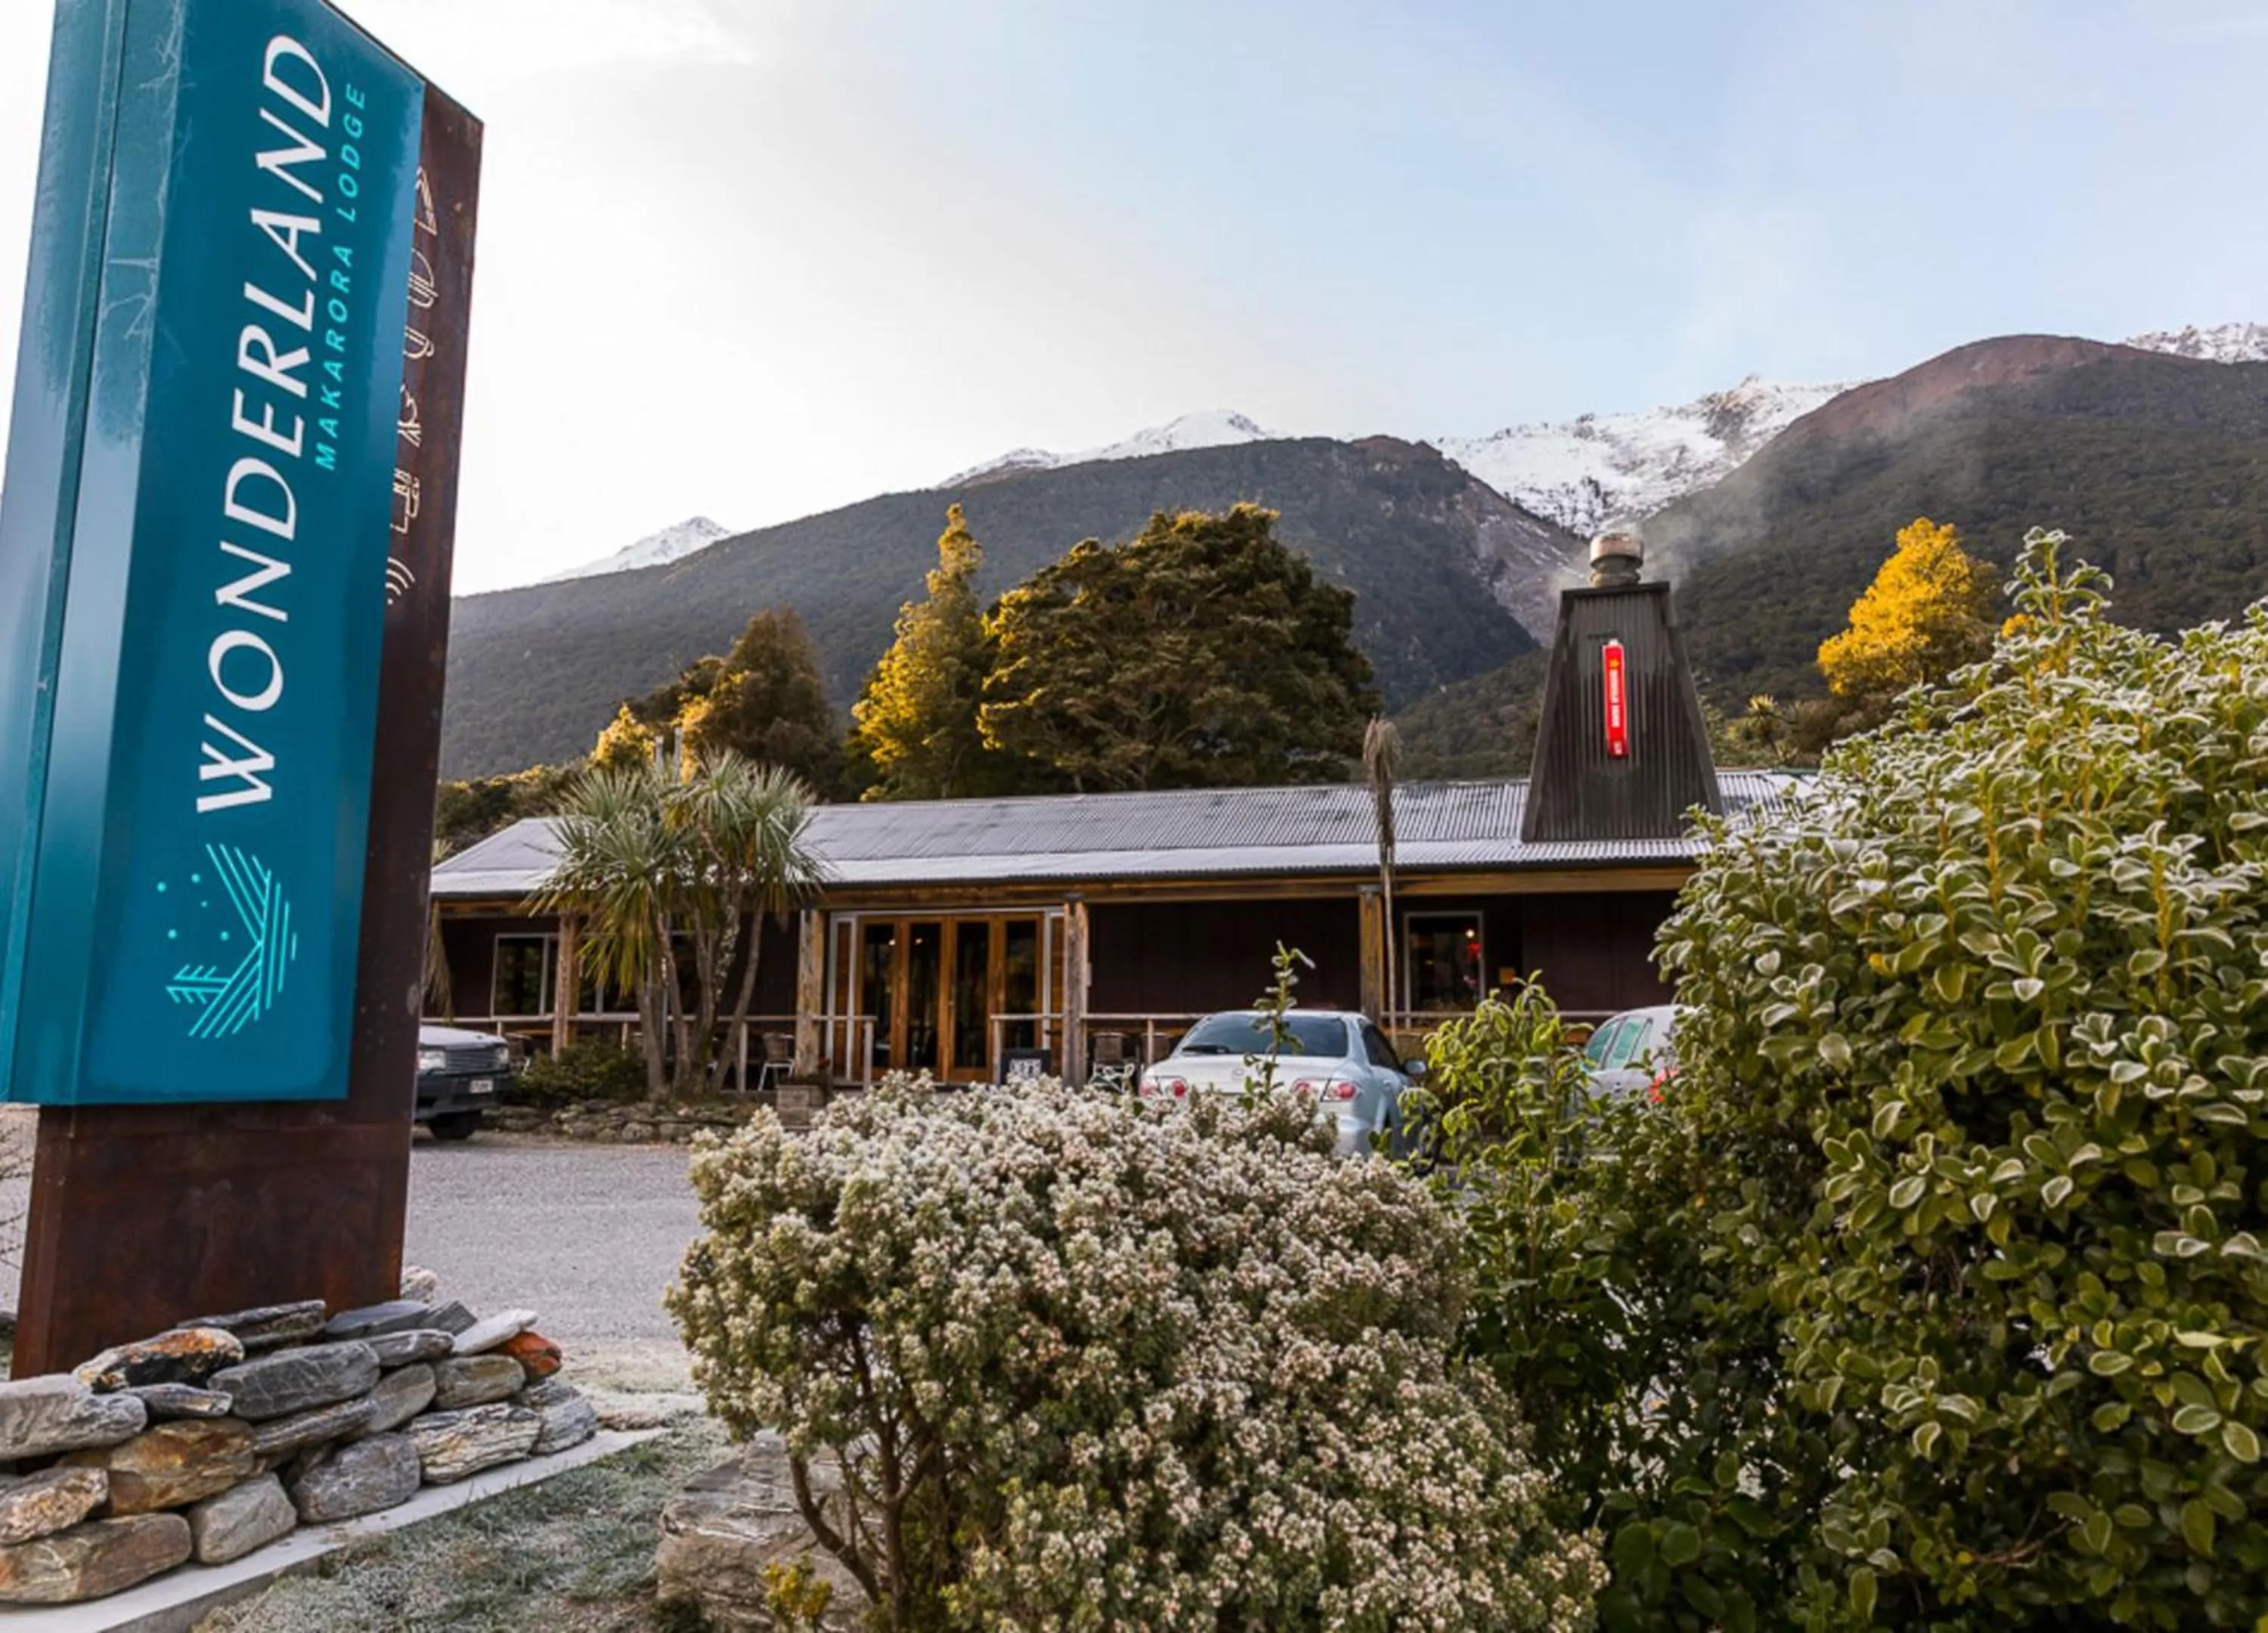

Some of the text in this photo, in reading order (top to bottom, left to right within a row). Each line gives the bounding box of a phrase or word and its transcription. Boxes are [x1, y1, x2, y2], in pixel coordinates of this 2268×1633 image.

[195, 34, 333, 814] WONDERLAND
[314, 83, 365, 471] MAKARORA LODGE
